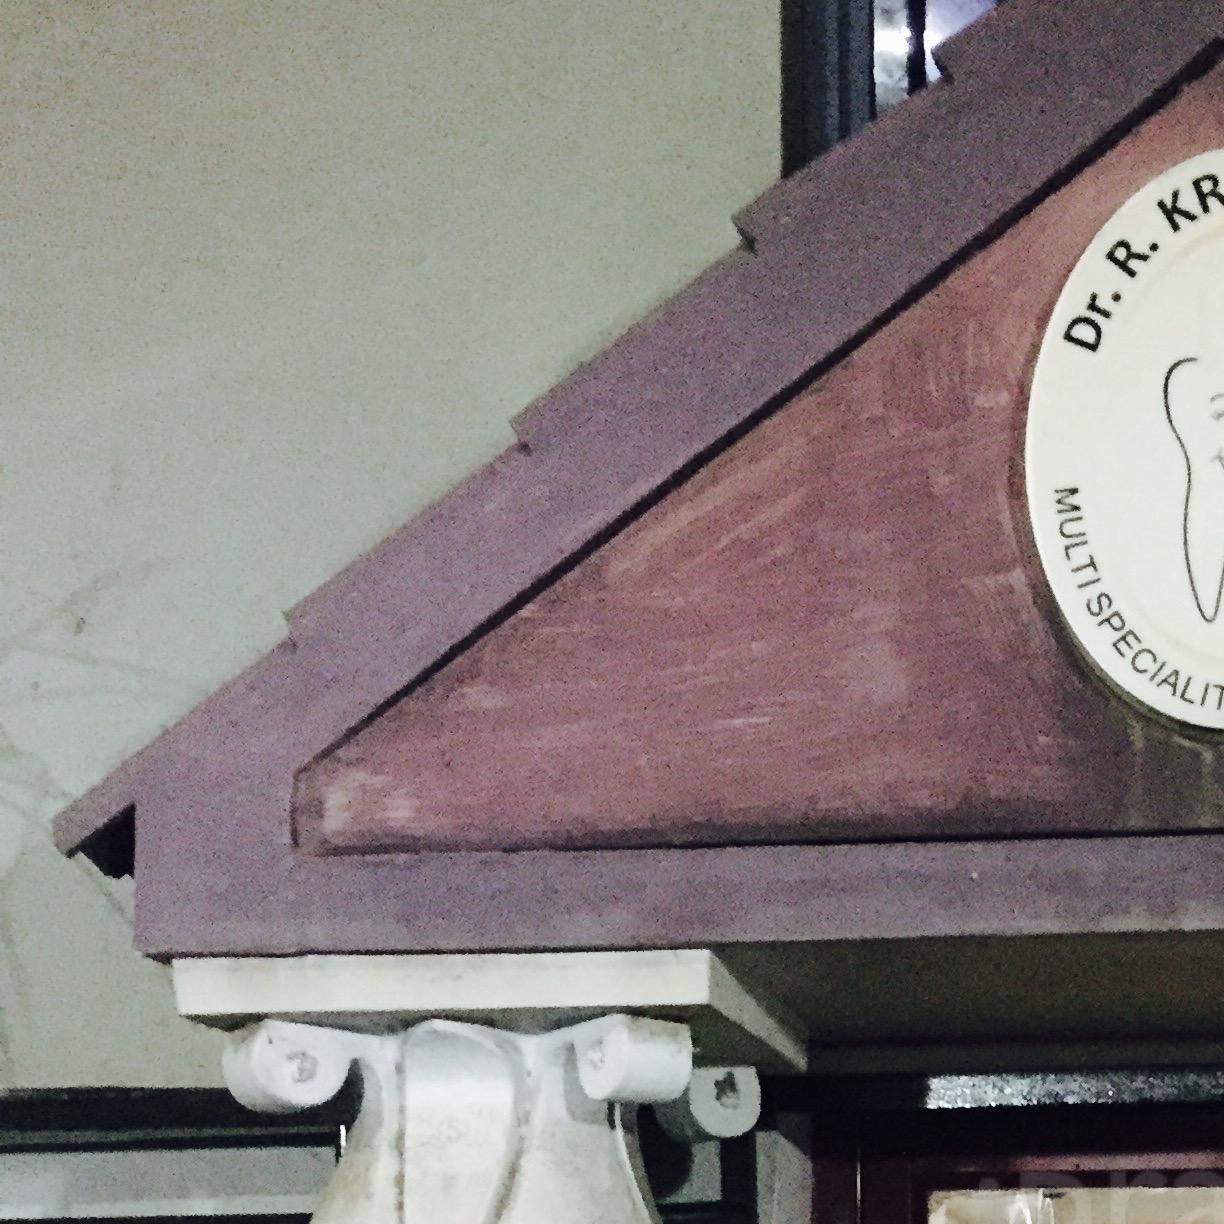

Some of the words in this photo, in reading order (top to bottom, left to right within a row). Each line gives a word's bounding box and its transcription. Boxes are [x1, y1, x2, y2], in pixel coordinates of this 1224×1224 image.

[1063, 290, 1122, 353] Dr.
[1105, 237, 1160, 280] R.
[1053, 486, 1102, 590] MULTI
